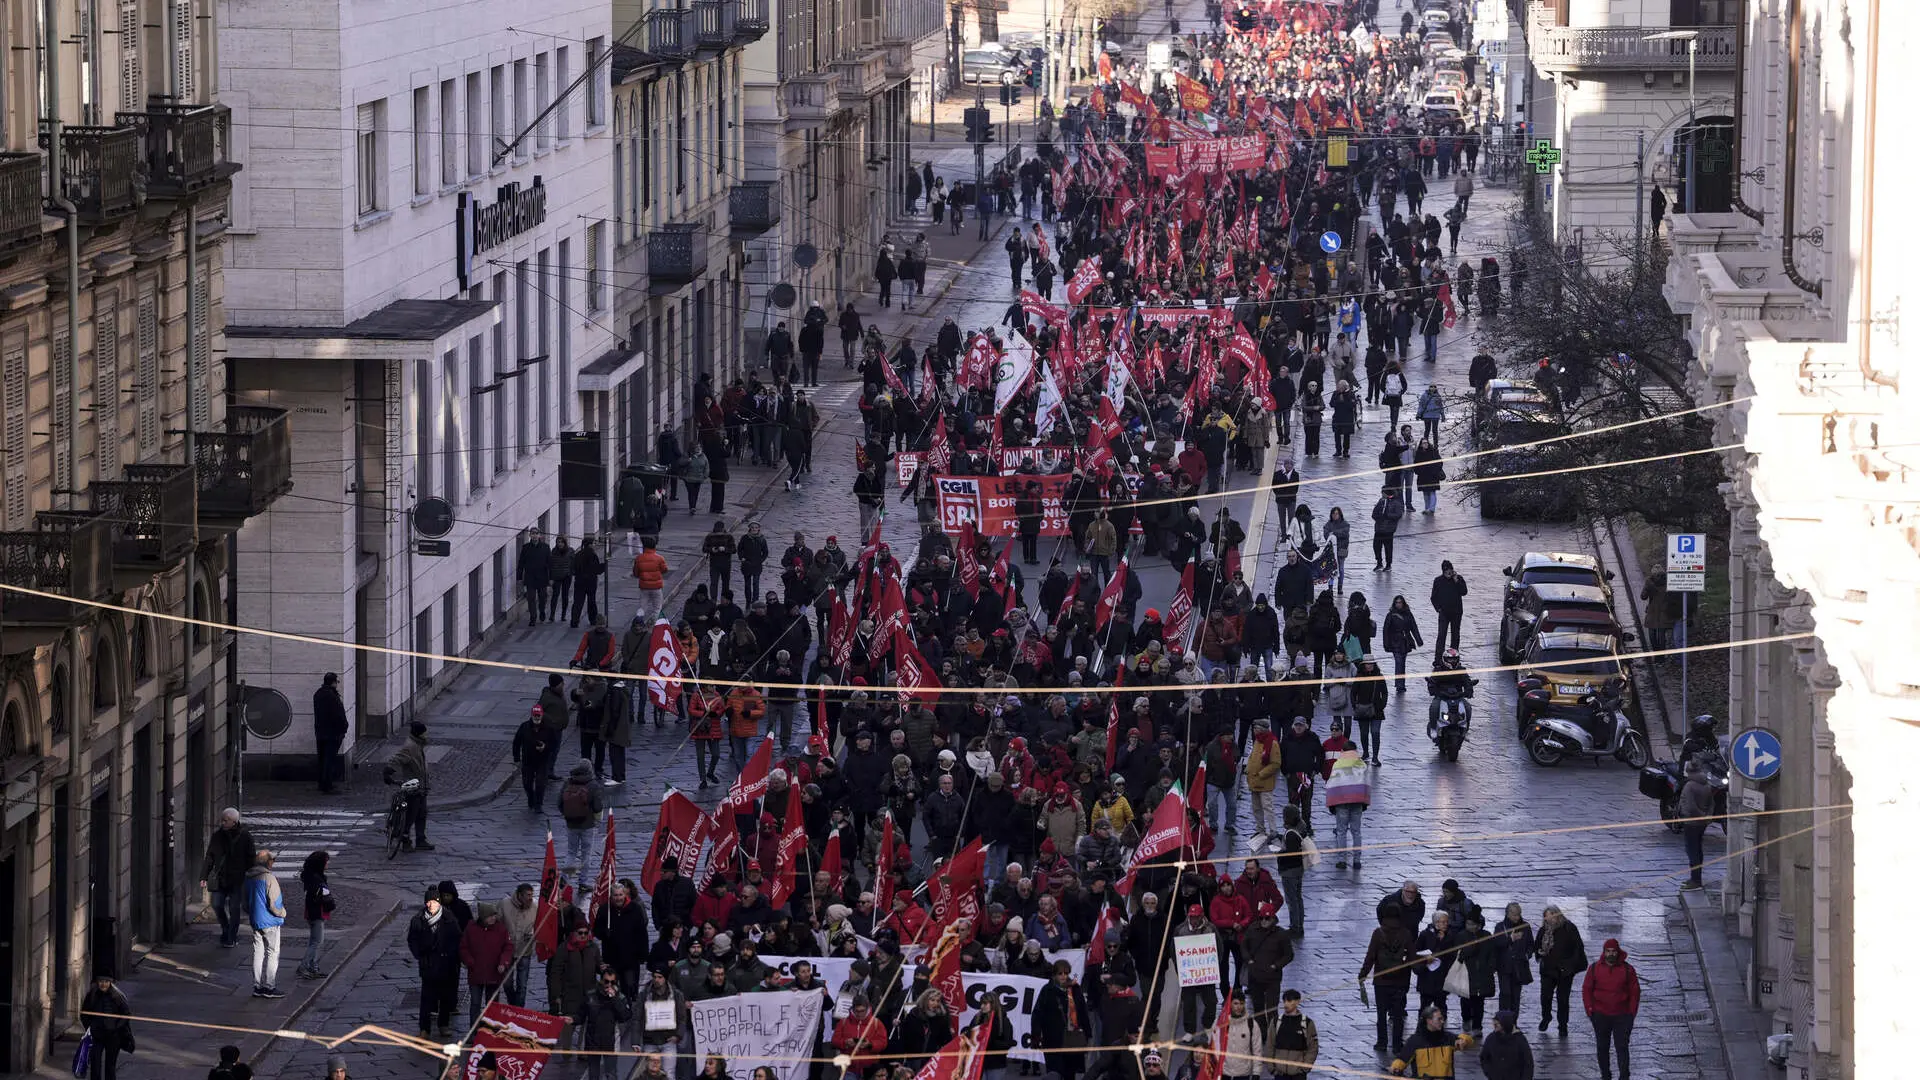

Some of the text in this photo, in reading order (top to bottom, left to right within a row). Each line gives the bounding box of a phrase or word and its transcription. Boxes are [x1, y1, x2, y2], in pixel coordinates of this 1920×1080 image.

[940, 480, 976, 494] CGIL
[965, 983, 1035, 1015] CGI
[694, 1005, 762, 1028] APPALTI
[780, 1005, 791, 1021] E
[697, 1020, 790, 1044] SUBAPPALTI
